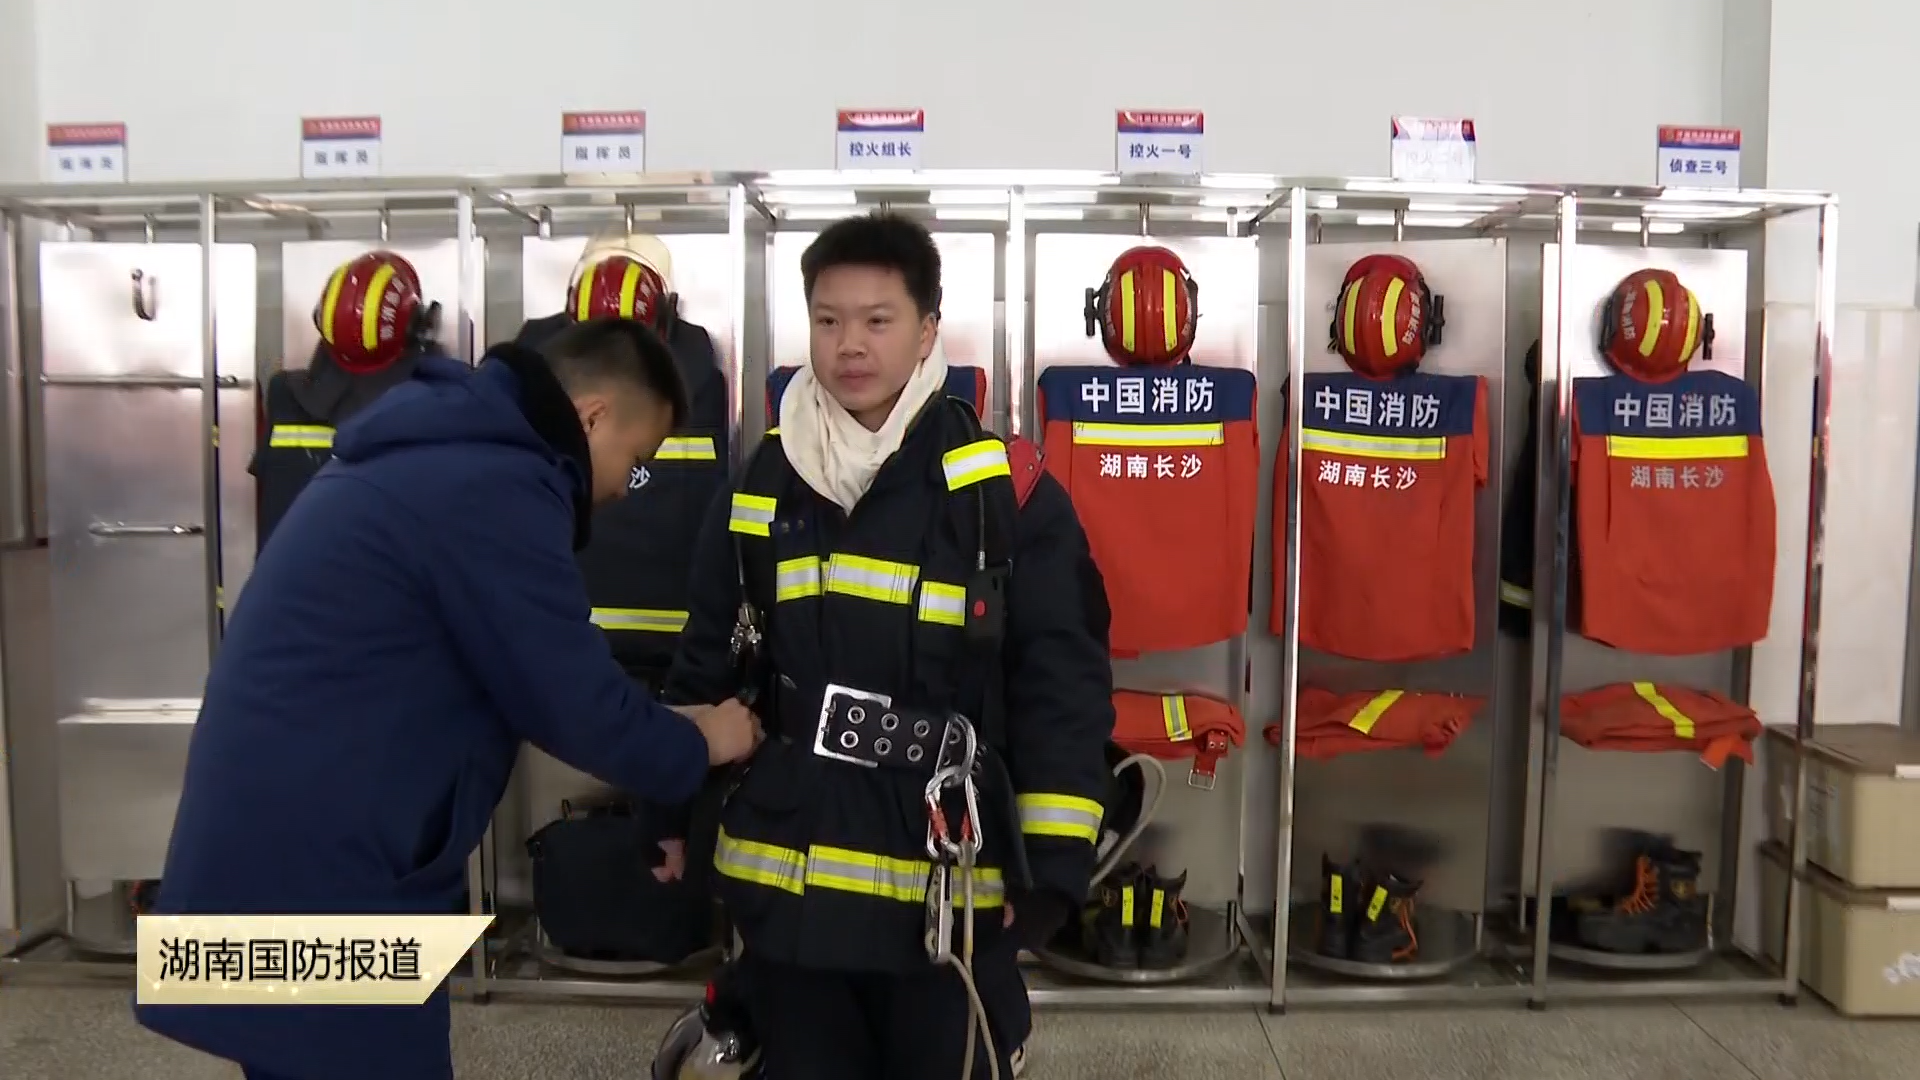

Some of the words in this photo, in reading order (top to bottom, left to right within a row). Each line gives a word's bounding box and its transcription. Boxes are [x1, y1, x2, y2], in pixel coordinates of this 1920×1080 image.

[849, 141, 912, 157] 控火组长
[1130, 143, 1192, 159] 控火一号
[1669, 158, 1728, 175] 侦查三号
[1081, 376, 1214, 414] 中国消防
[1314, 385, 1441, 429] 中国消防
[1614, 392, 1737, 428] 中国消防
[1099, 453, 1202, 480] 湖南长沙
[1318, 459, 1418, 490] 湖南长沙
[1630, 465, 1724, 489] 湖南长沙
